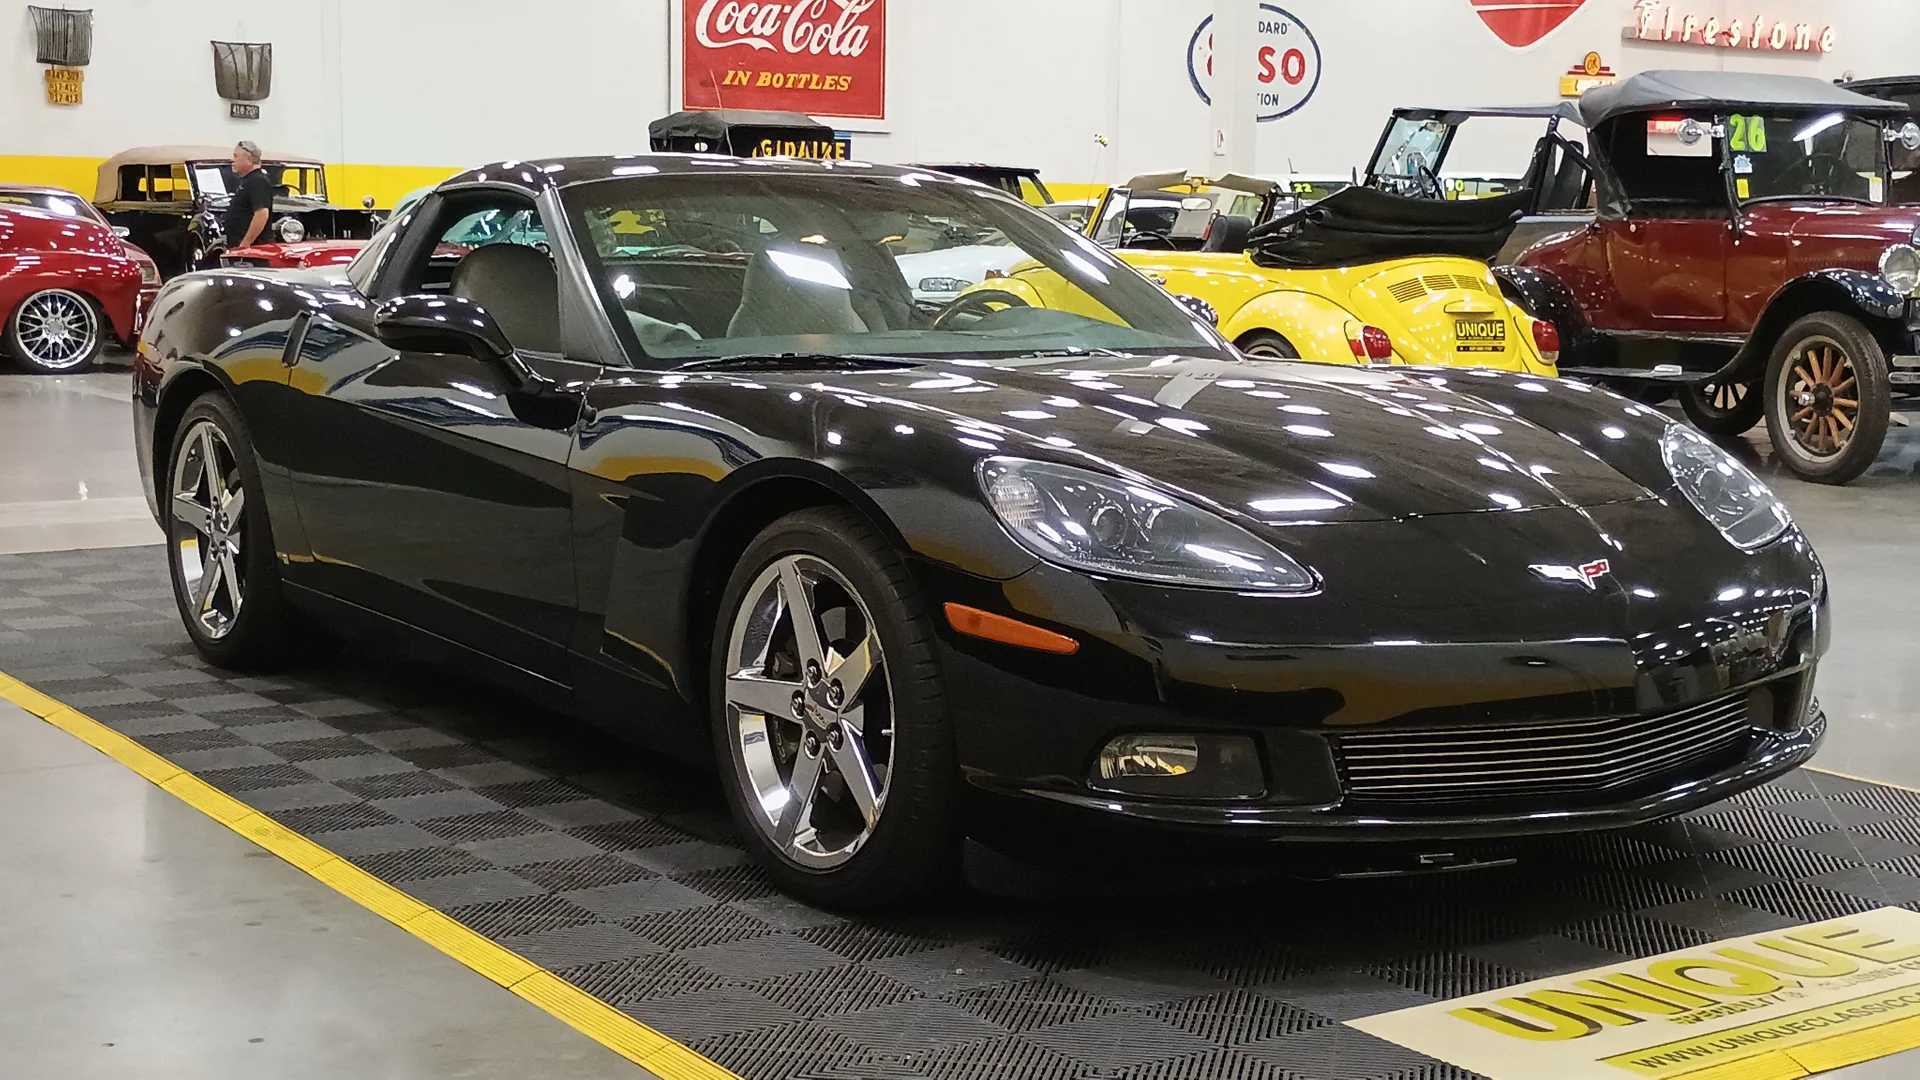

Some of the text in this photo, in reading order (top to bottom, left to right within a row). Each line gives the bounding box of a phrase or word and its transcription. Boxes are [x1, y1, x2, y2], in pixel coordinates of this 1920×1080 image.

[695, 0, 874, 57] Coca-Cola
[1258, 21, 1288, 35] DARD
[1633, 0, 1836, 53] Firestone
[1257, 46, 1306, 85] SO
[722, 70, 852, 92] IN BOTTLES
[1729, 113, 1766, 151] 26
[752, 138, 846, 160] GIDAIRE
[1294, 183, 1313, 193] 22
[1456, 322, 1505, 337] UNIQUE
[1447, 923, 1920, 1042] UNIQUE
